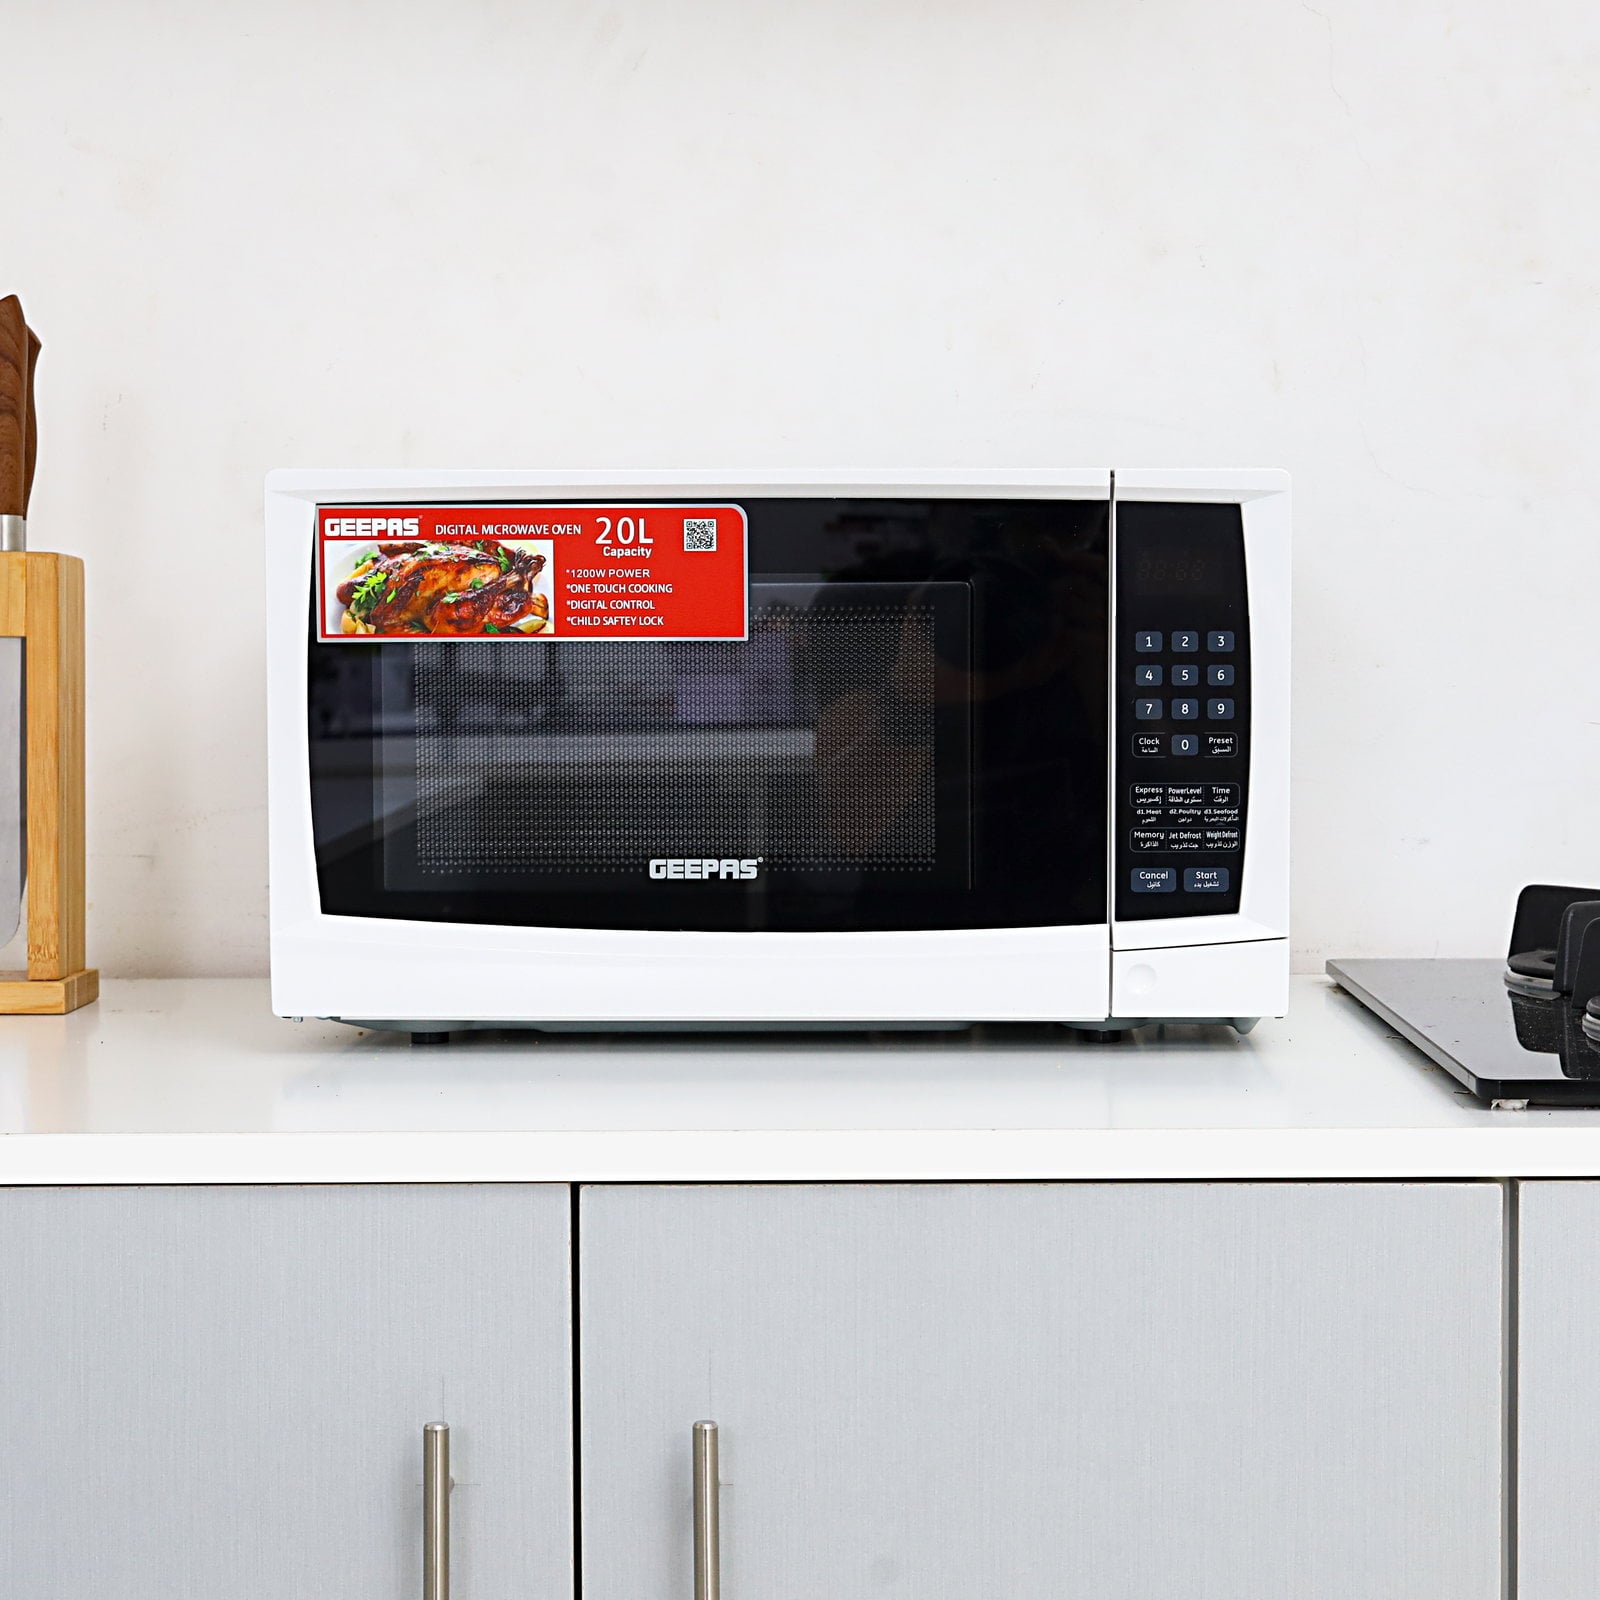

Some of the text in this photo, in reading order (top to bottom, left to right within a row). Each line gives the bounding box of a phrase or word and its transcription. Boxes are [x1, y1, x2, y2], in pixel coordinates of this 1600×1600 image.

[324, 518, 419, 537] GEEPAS
[435, 524, 582, 535] DIGITAL MICROWAVE OVEN
[595, 516, 654, 545] 20L
[603, 546, 652, 559] Capacity
[608, 568, 651, 578] POWER
[593, 583, 626, 593] TOUCH
[628, 583, 673, 593] COOKING
[610, 600, 656, 610] CONTROL
[602, 616, 637, 626] SAFTEY
[639, 616, 665, 626] LOCK
[1145, 636, 1153, 647] 1
[1181, 636, 1189, 647] 2
[1217, 636, 1225, 647] 3
[1145, 670, 1153, 681] 4
[1181, 670, 1189, 681] 5
[1217, 670, 1225, 681] 6
[1145, 703, 1153, 714] 7
[1181, 703, 1189, 714] 8
[1217, 703, 1225, 714] 9
[1138, 737, 1160, 745] Clock
[1181, 739, 1189, 751] 0
[1208, 736, 1233, 744] Preset
[1135, 786, 1163, 795] Express
[1212, 786, 1231, 794] Time
[1134, 831, 1164, 840] Memory
[1168, 831, 1202, 840] Jet Defrost
[1206, 830, 1222, 840] Weight
[649, 859, 758, 879] GEEPAS
[1139, 870, 1169, 879] Cancel
[1195, 871, 1217, 879] Start
